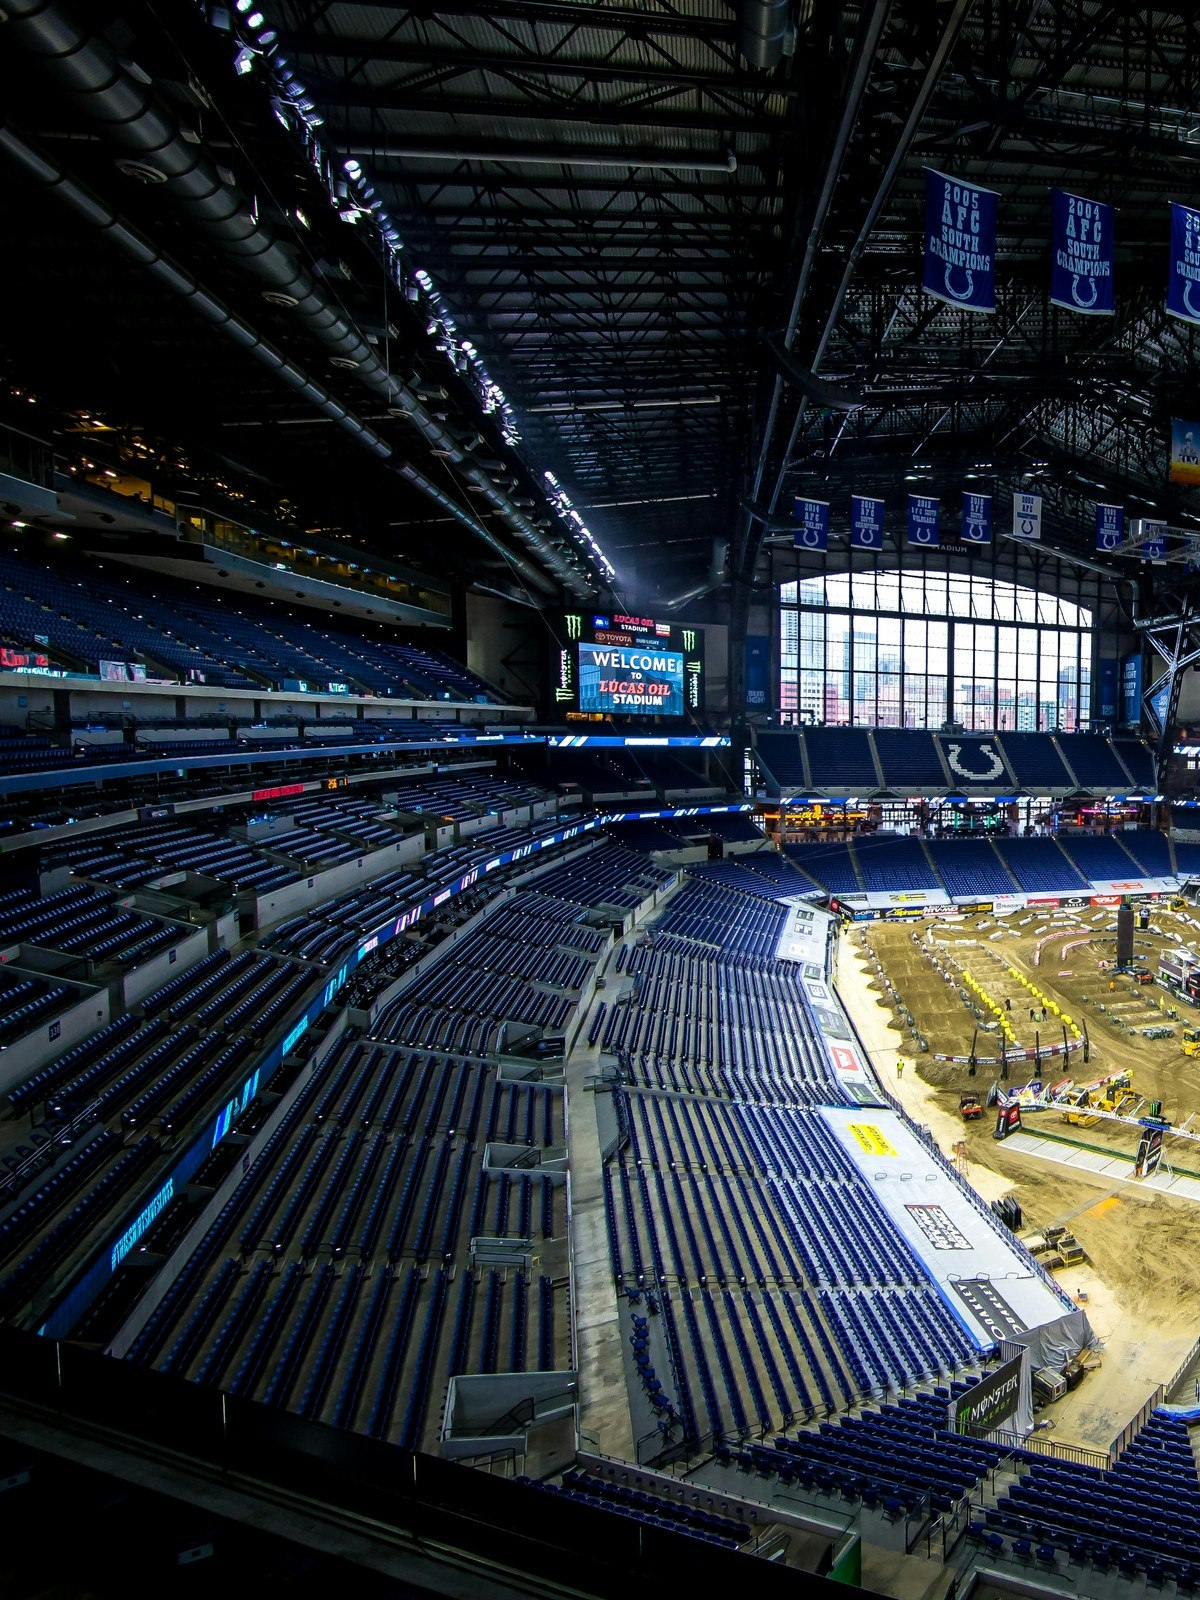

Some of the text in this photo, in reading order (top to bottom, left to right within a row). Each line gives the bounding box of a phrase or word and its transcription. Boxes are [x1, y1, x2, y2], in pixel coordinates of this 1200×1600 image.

[944, 182, 979, 209] 2005
[942, 200, 980, 234] AFC
[1069, 198, 1100, 220] 2004
[942, 225, 979, 253] SOUTH
[1066, 214, 1102, 243] AFC
[930, 236, 990, 272] CHAMPIONS
[1067, 239, 1100, 260] SOUTH
[1056, 249, 1110, 276] CHAMPIONS
[614, 615, 640, 626] LUCAS
[641, 617, 654, 628] OIL
[621, 624, 648, 633] STADIUM
[606, 634, 632, 643] TOYOTA
[593, 651, 678, 672] WELCOME
[600, 680, 671, 696] LUCAS OIL
[630, 672, 642, 680] TO
[613, 694, 662, 705] STADIUM
[958, 1284, 1006, 1340] OAKLEY
[978, 1283, 1024, 1334] OAKLEY
[971, 1374, 1018, 1421] MONSTER
